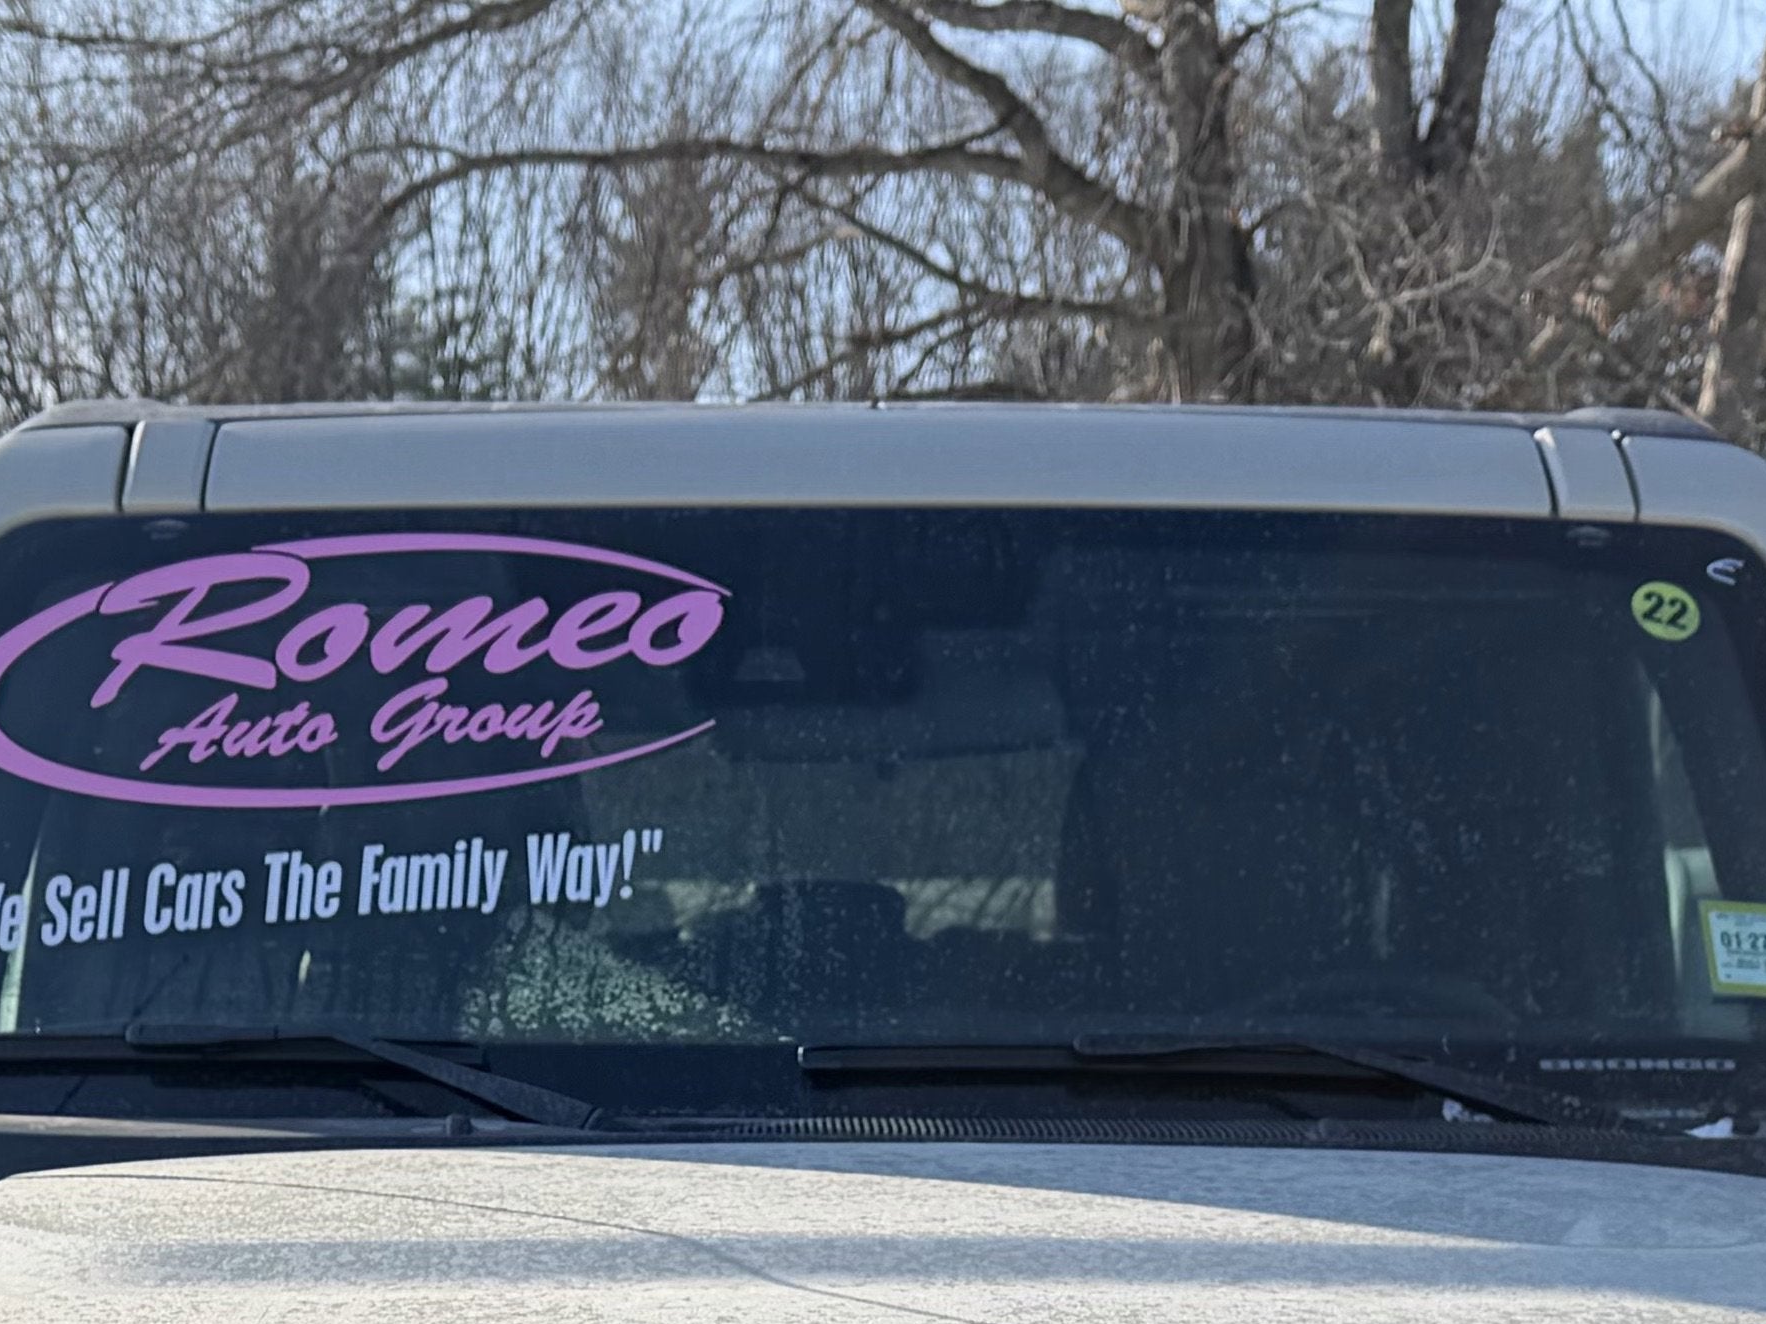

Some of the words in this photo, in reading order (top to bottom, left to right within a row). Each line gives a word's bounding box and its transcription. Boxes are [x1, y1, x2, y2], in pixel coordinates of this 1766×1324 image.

[92, 551, 724, 708] Romeo
[1642, 590, 1688, 631] 22
[140, 693, 337, 770] Auto
[372, 677, 604, 771] Group
[40, 866, 131, 947] Sell
[142, 862, 247, 935] Cars
[263, 850, 343, 924] The
[357, 836, 509, 916] Family
[526, 827, 664, 909] Way!"
